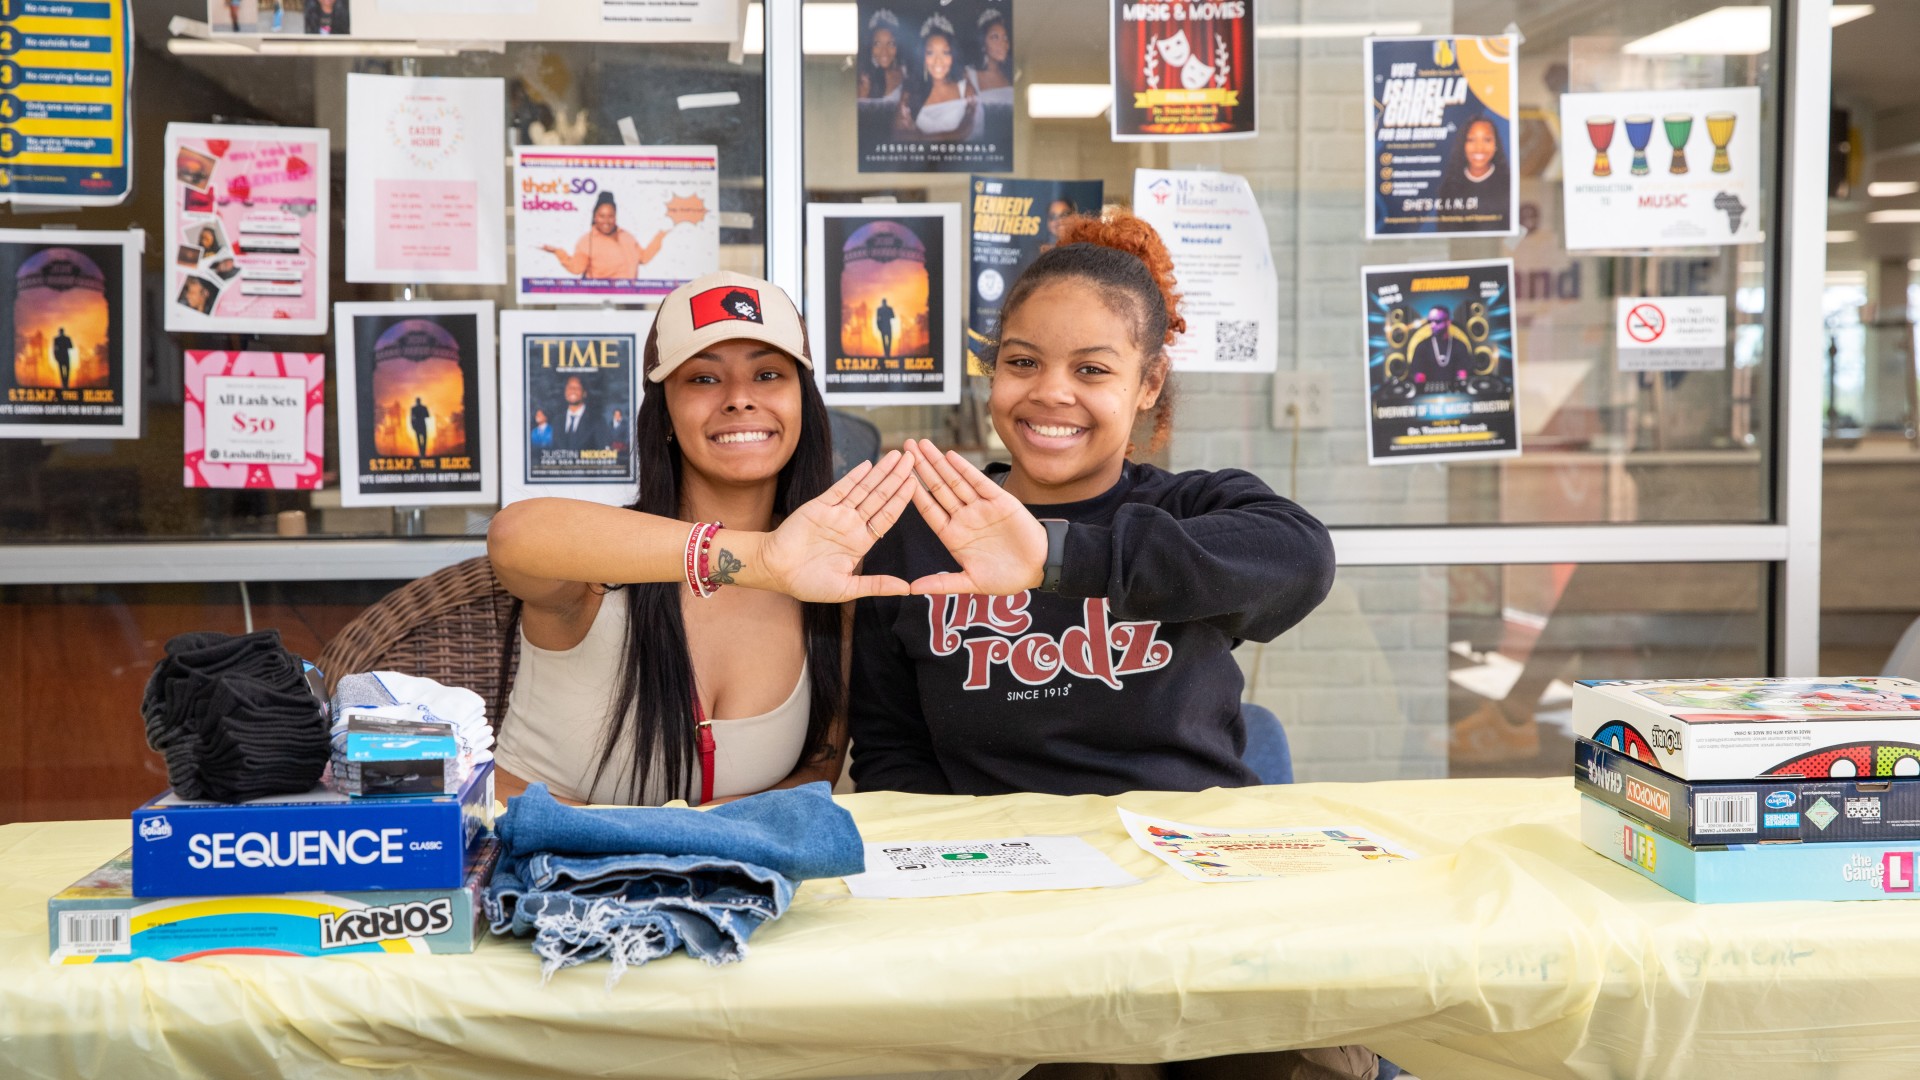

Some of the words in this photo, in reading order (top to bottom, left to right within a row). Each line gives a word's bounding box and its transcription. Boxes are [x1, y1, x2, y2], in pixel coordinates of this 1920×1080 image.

[25, 3, 37, 12] No
[1123, 4, 1170, 21] MUSIC
[1174, 4, 1186, 20] &
[1189, 2, 1246, 21] MOVIES
[0, 31, 12, 50] 2
[25, 37, 37, 47] No
[38, 39, 69, 48] outside
[69, 39, 90, 48] food
[0, 65, 12, 84] 3
[25, 71, 37, 80] No
[38, 72, 73, 83] carrying
[74, 72, 94, 82] food
[95, 74, 110, 82] out
[1391, 62, 1417, 78] VOTE
[1383, 78, 1468, 105] ISABELLA
[0, 99, 13, 118] 4
[25, 102, 45, 111] Only
[46, 104, 62, 112] one
[63, 104, 87, 113] swipe
[409, 126, 442, 136] EASTER
[1, 133, 13, 152] 5
[411, 138, 441, 147] HOURS
[875, 144, 925, 153] JESSICA
[930, 143, 997, 153] MCDONALD
[1176, 180, 1193, 193] My
[1575, 184, 1633, 193] INTRODUCTION
[974, 195, 1033, 216] KENNEDY
[1176, 194, 1218, 206] House
[1638, 193, 1688, 208] MUSIC
[974, 215, 1041, 236] BROTHERS
[1173, 221, 1231, 230] Volunteers
[1181, 236, 1222, 244] Needed
[534, 340, 620, 368] TIME
[218, 394, 236, 406] All
[239, 394, 268, 406] Lash
[272, 395, 298, 407] Sets
[1378, 405, 1417, 419] OVERVIEW
[1472, 399, 1510, 414] INDUSTRY
[232, 411, 275, 434] $50
[541, 449, 578, 459] JUSTIN
[580, 449, 618, 459] NIXON
[687, 542, 696, 567] Sigma
[963, 597, 1173, 690] rodz
[1006, 689, 1040, 701] SINCE
[1043, 686, 1069, 698] 1913
[1652, 729, 1682, 752] TROUBLE
[1627, 780, 1669, 813] MONOPOLY
[1768, 798, 1793, 808] Hasbro
[139, 822, 172, 836] Goliath
[188, 828, 404, 869] SEQUENCE
[409, 841, 443, 851] CLASSIC
[1625, 828, 1653, 868] LIFE
[1851, 853, 1873, 868] the
[1843, 862, 1885, 882] Game
[1871, 876, 1884, 890] of
[324, 902, 449, 944] SORRY!
